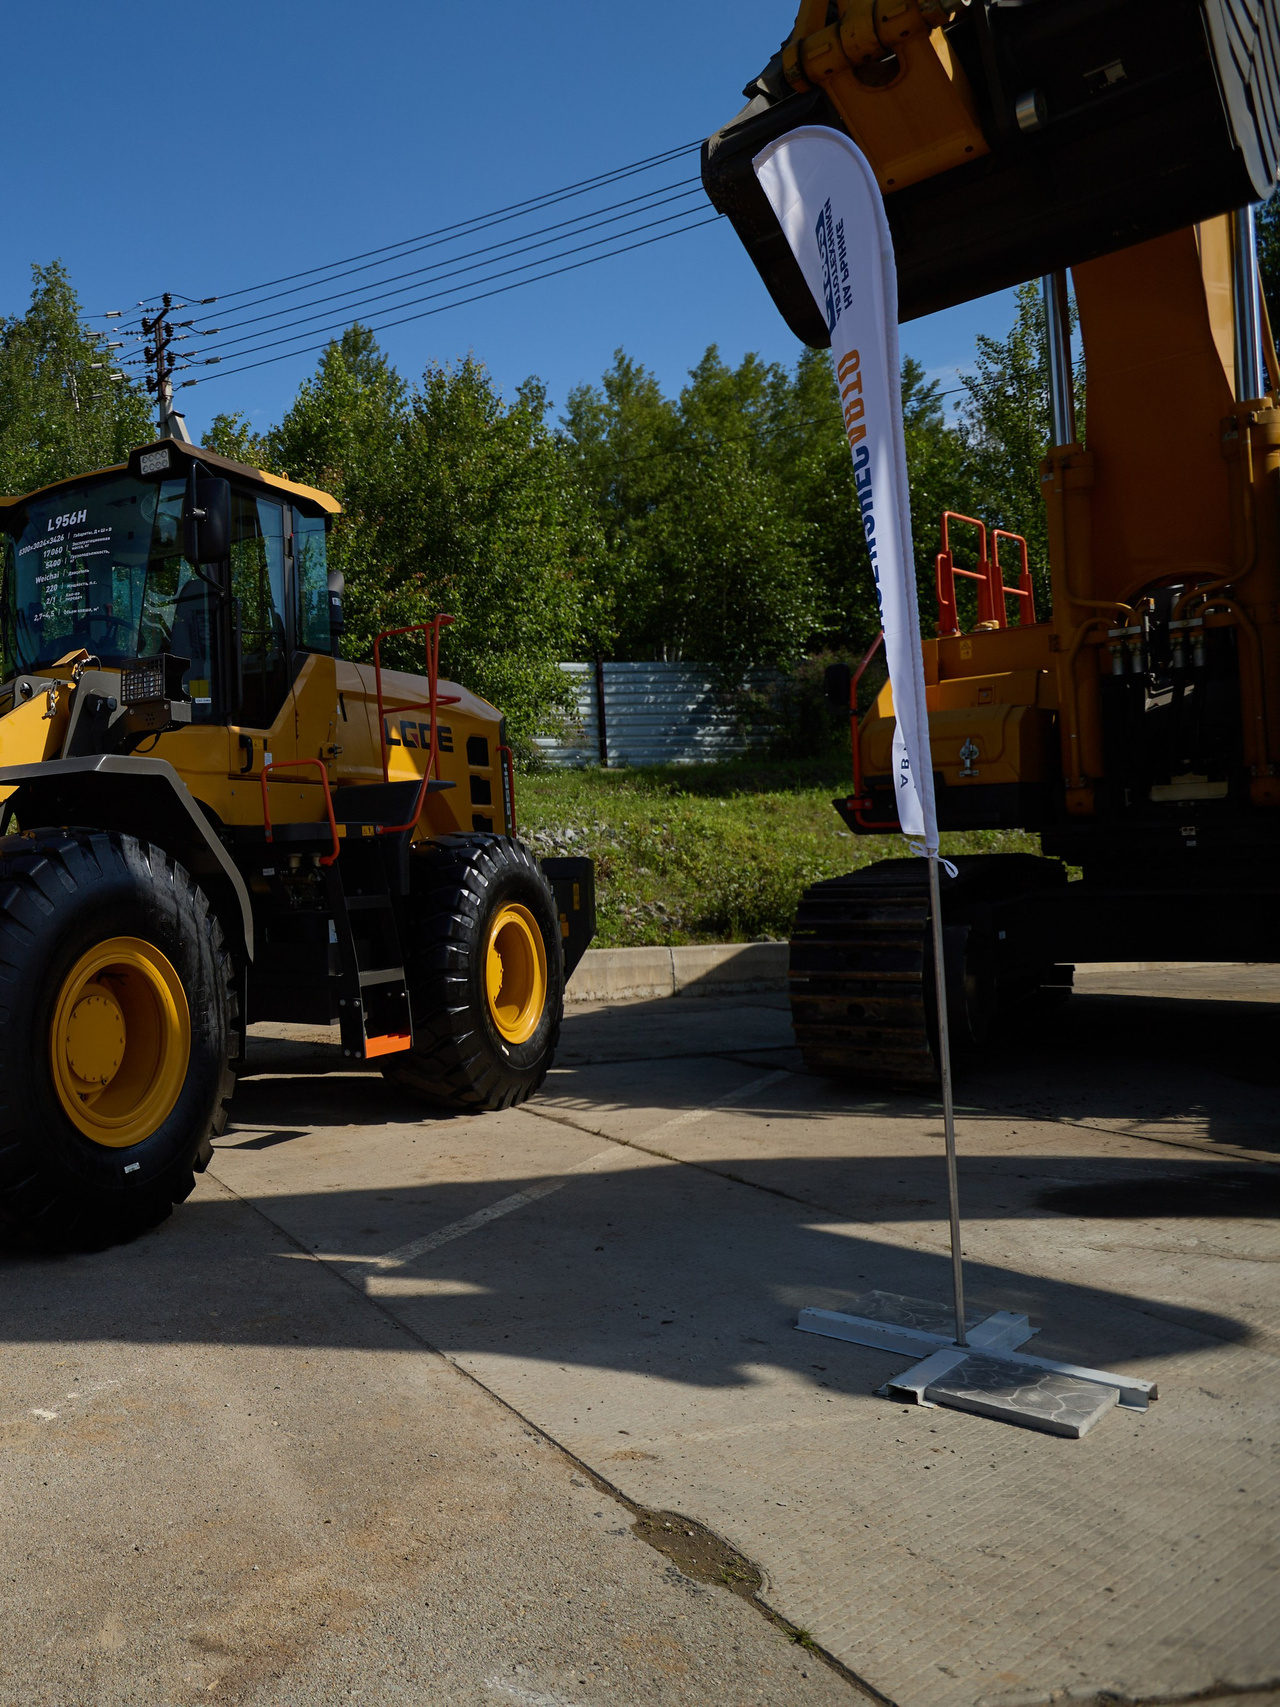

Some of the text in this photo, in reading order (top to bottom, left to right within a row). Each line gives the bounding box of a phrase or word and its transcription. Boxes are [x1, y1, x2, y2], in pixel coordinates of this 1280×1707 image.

[47, 509, 88, 532] L956H
[35, 570, 60, 584] Weichai
[45, 583, 58, 593] 220
